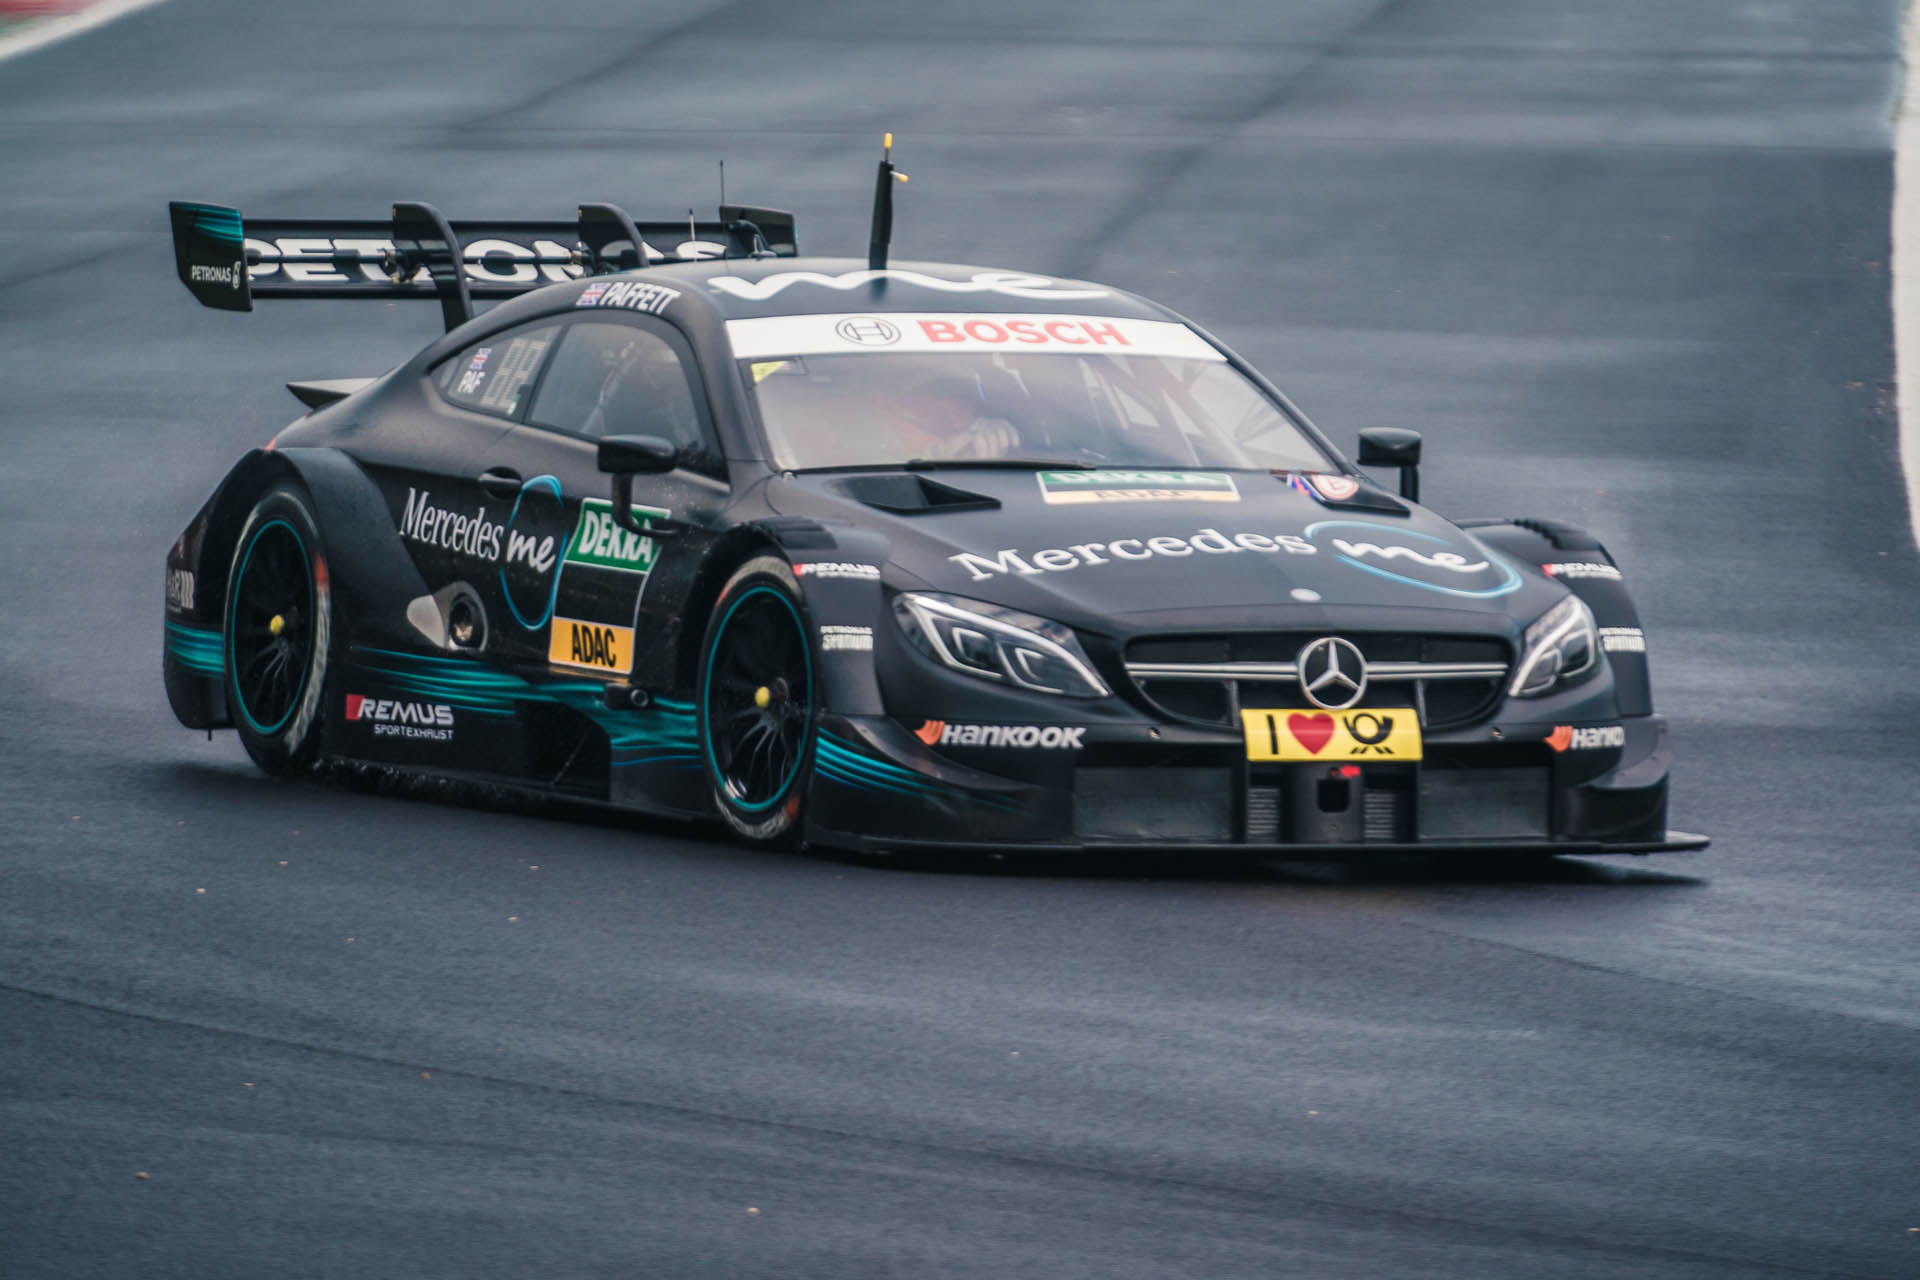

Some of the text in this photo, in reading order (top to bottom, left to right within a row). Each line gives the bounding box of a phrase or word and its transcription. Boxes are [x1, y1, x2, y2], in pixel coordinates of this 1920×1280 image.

[191, 265, 231, 283] PETRONAS
[599, 281, 682, 315] PAFFETT
[917, 319, 1132, 347] BOSCH
[400, 487, 556, 573] Mercedes me
[948, 529, 1490, 582] Mercedes me
[571, 623, 617, 668] ADAC
[357, 698, 455, 726] REMUS
[374, 724, 455, 740] SPORTEXHAUST
[1267, 714, 1279, 755] I
